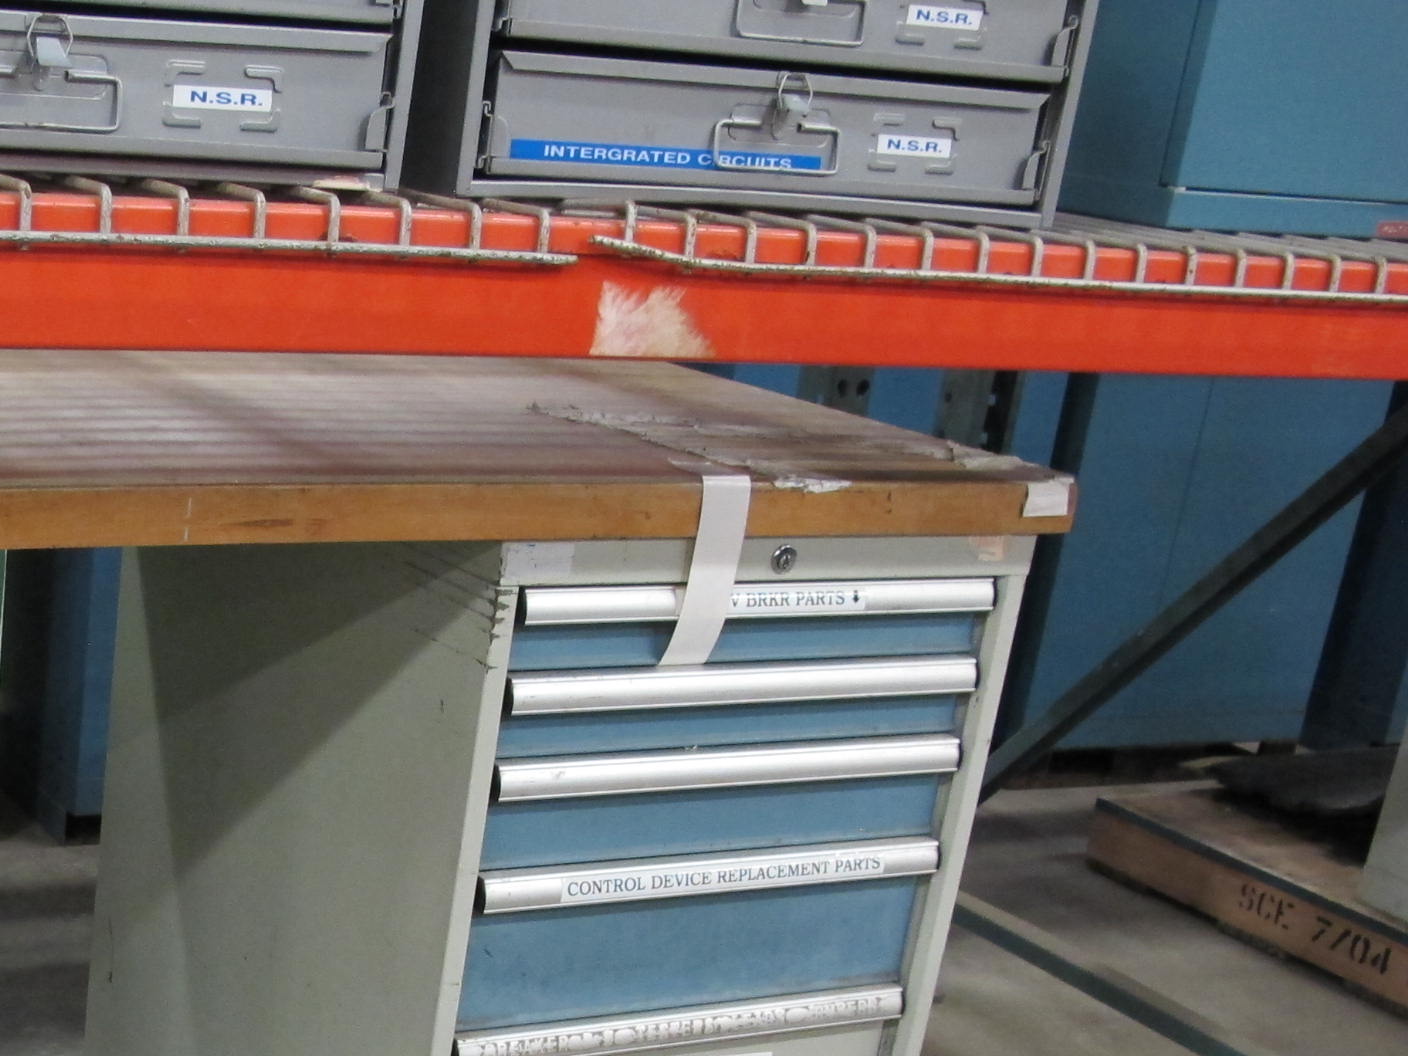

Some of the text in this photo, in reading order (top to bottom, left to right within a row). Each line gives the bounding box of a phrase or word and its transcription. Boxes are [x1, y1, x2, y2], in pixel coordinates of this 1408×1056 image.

[915, 9, 972, 27] N.S.R.
[190, 90, 263, 106] N.S.R.
[887, 137, 942, 154] N.S.R.
[543, 144, 792, 169] INTERGRATED CRCUITS
[746, 592, 791, 608] BRKR
[796, 591, 846, 606] PARTS
[567, 856, 881, 897] CONTROL DEVICE REPLACEMENT PARTS
